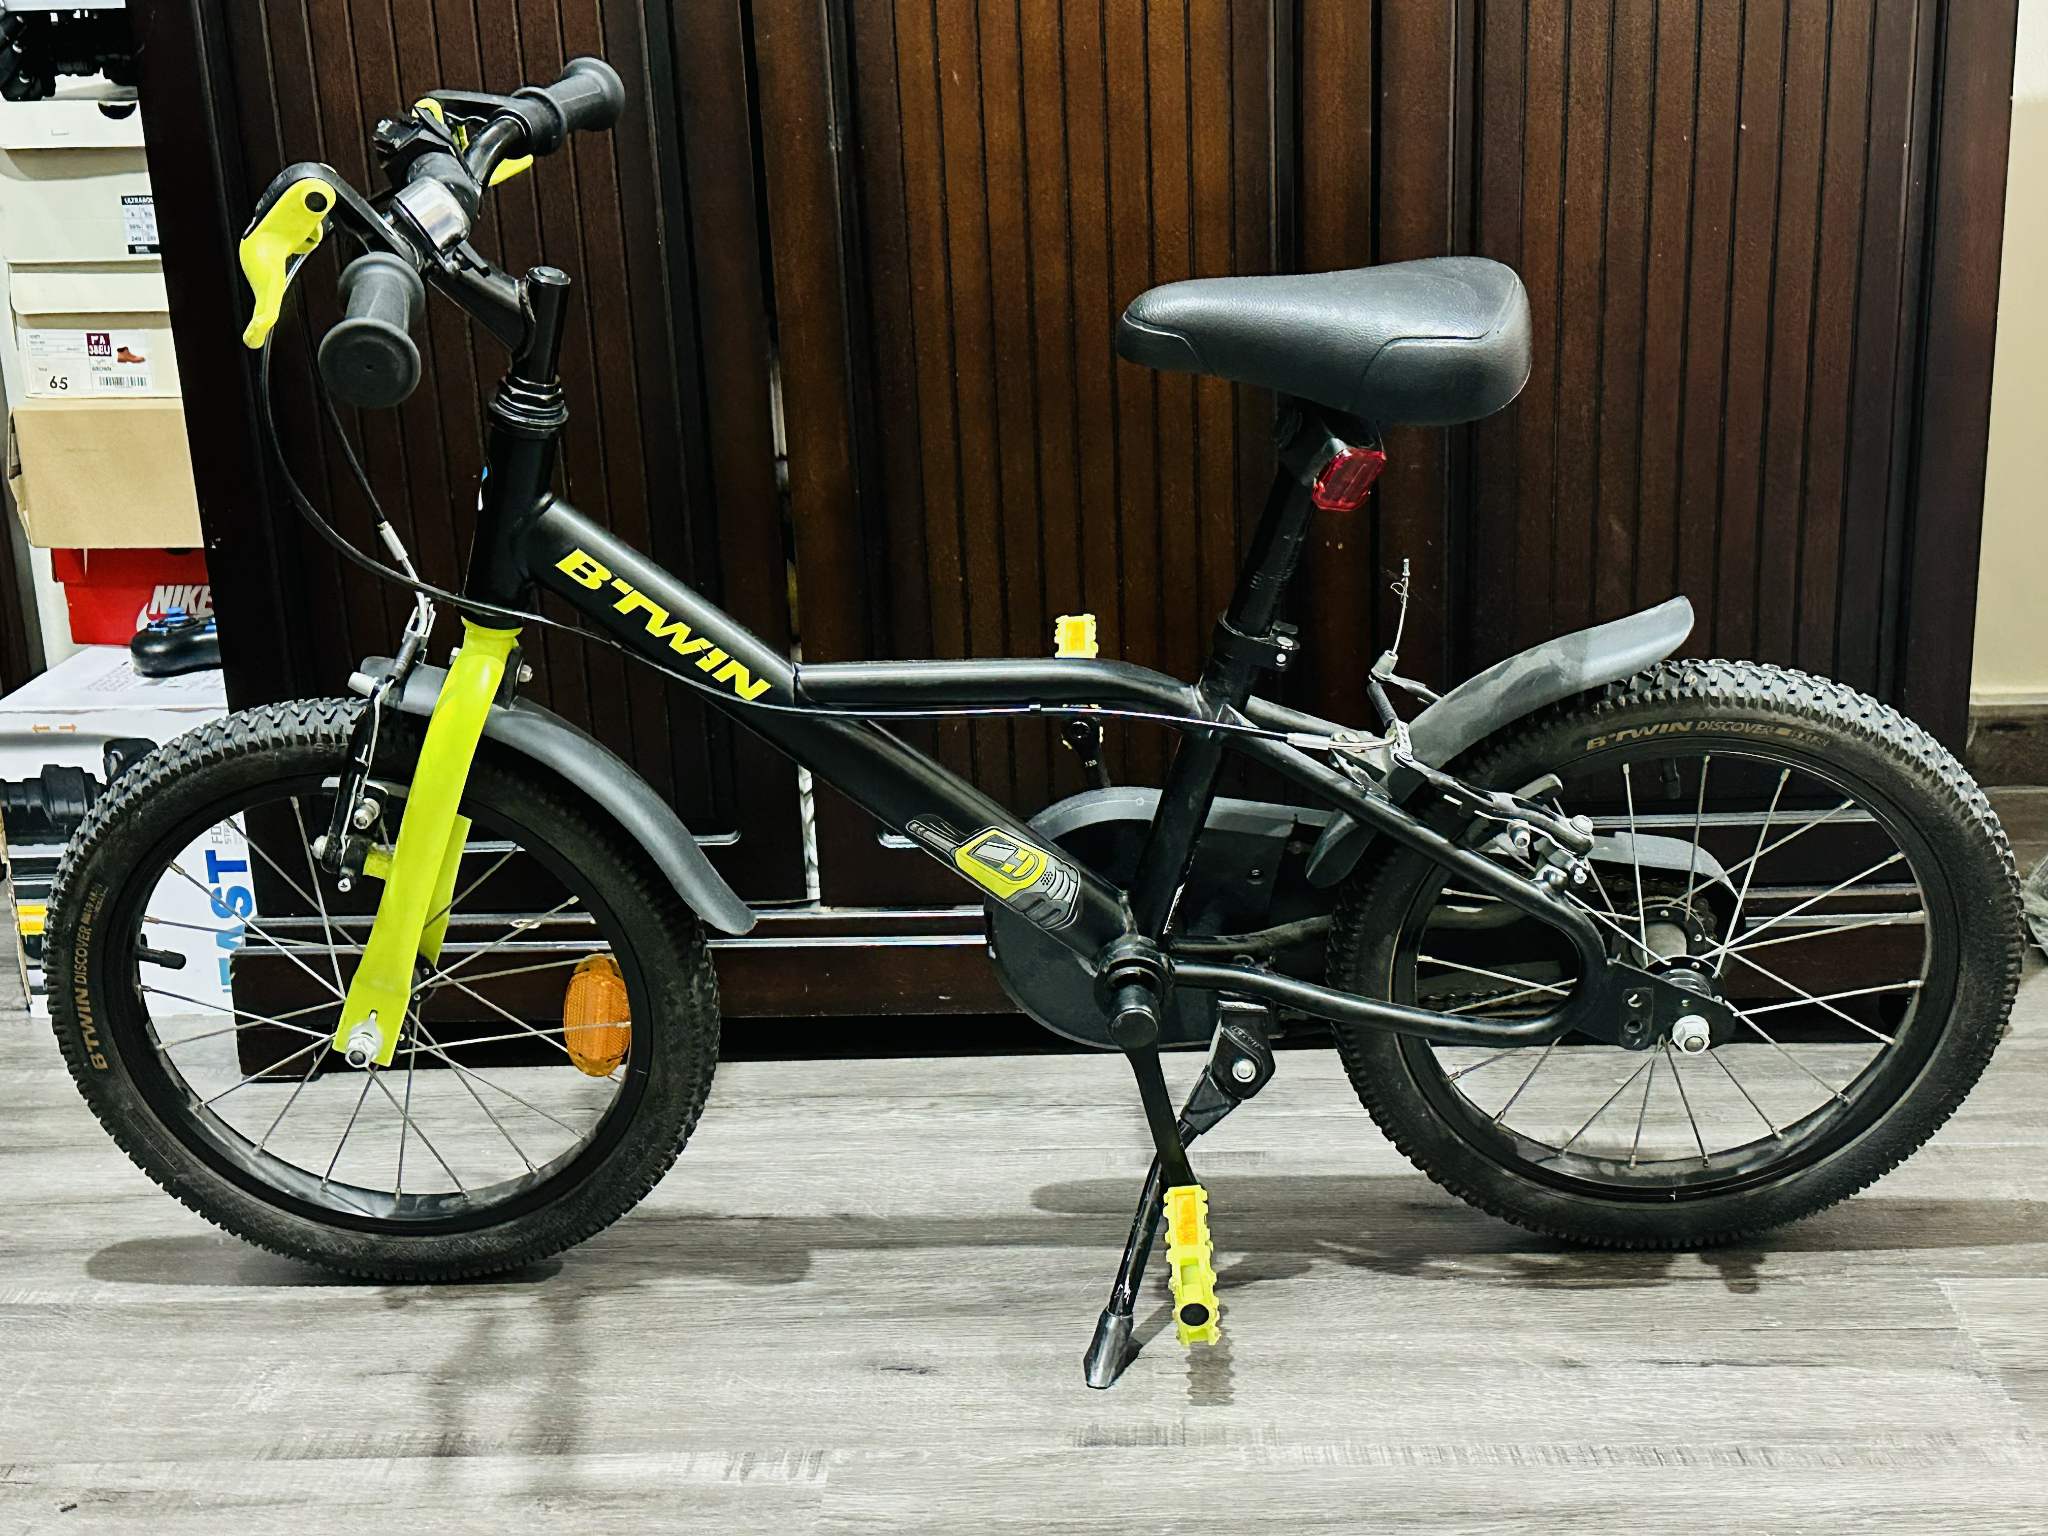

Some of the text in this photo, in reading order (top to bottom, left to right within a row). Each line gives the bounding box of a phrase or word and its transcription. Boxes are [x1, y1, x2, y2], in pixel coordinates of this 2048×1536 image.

[49, 376, 68, 390] 65
[149, 585, 214, 617] NIKE
[74, 925, 93, 985] DISCOVER
